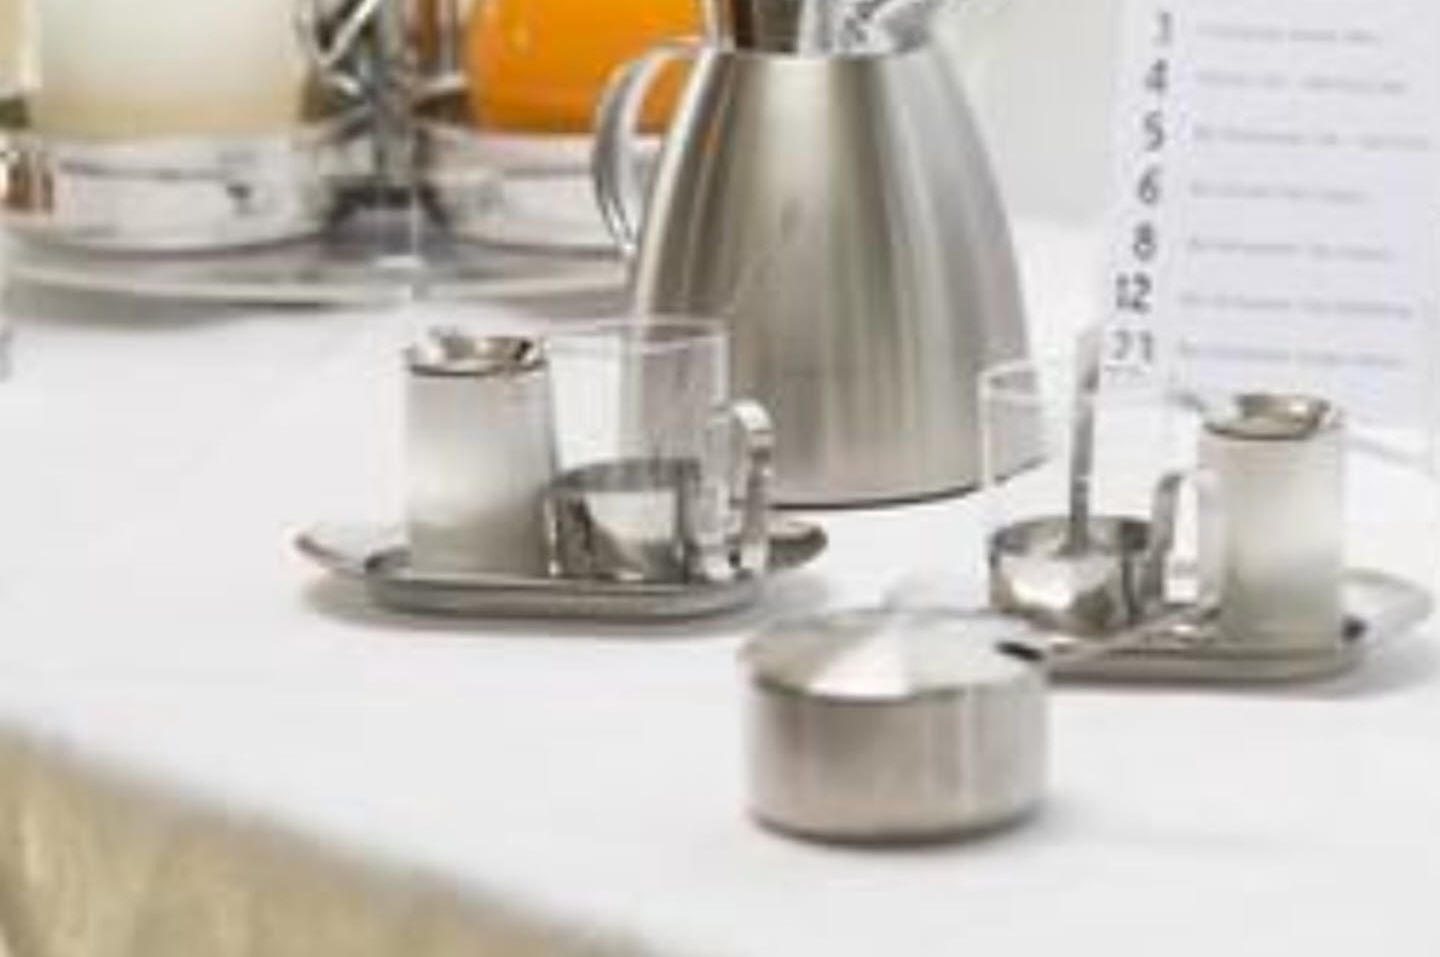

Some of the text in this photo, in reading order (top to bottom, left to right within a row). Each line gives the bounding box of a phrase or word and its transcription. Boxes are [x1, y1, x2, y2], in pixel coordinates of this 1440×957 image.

[1143, 57, 1167, 93] 4
[1143, 108, 1165, 151] 5
[1136, 166, 1162, 206] 6
[1132, 221, 1156, 262] 8
[1113, 272, 1153, 314] 12
